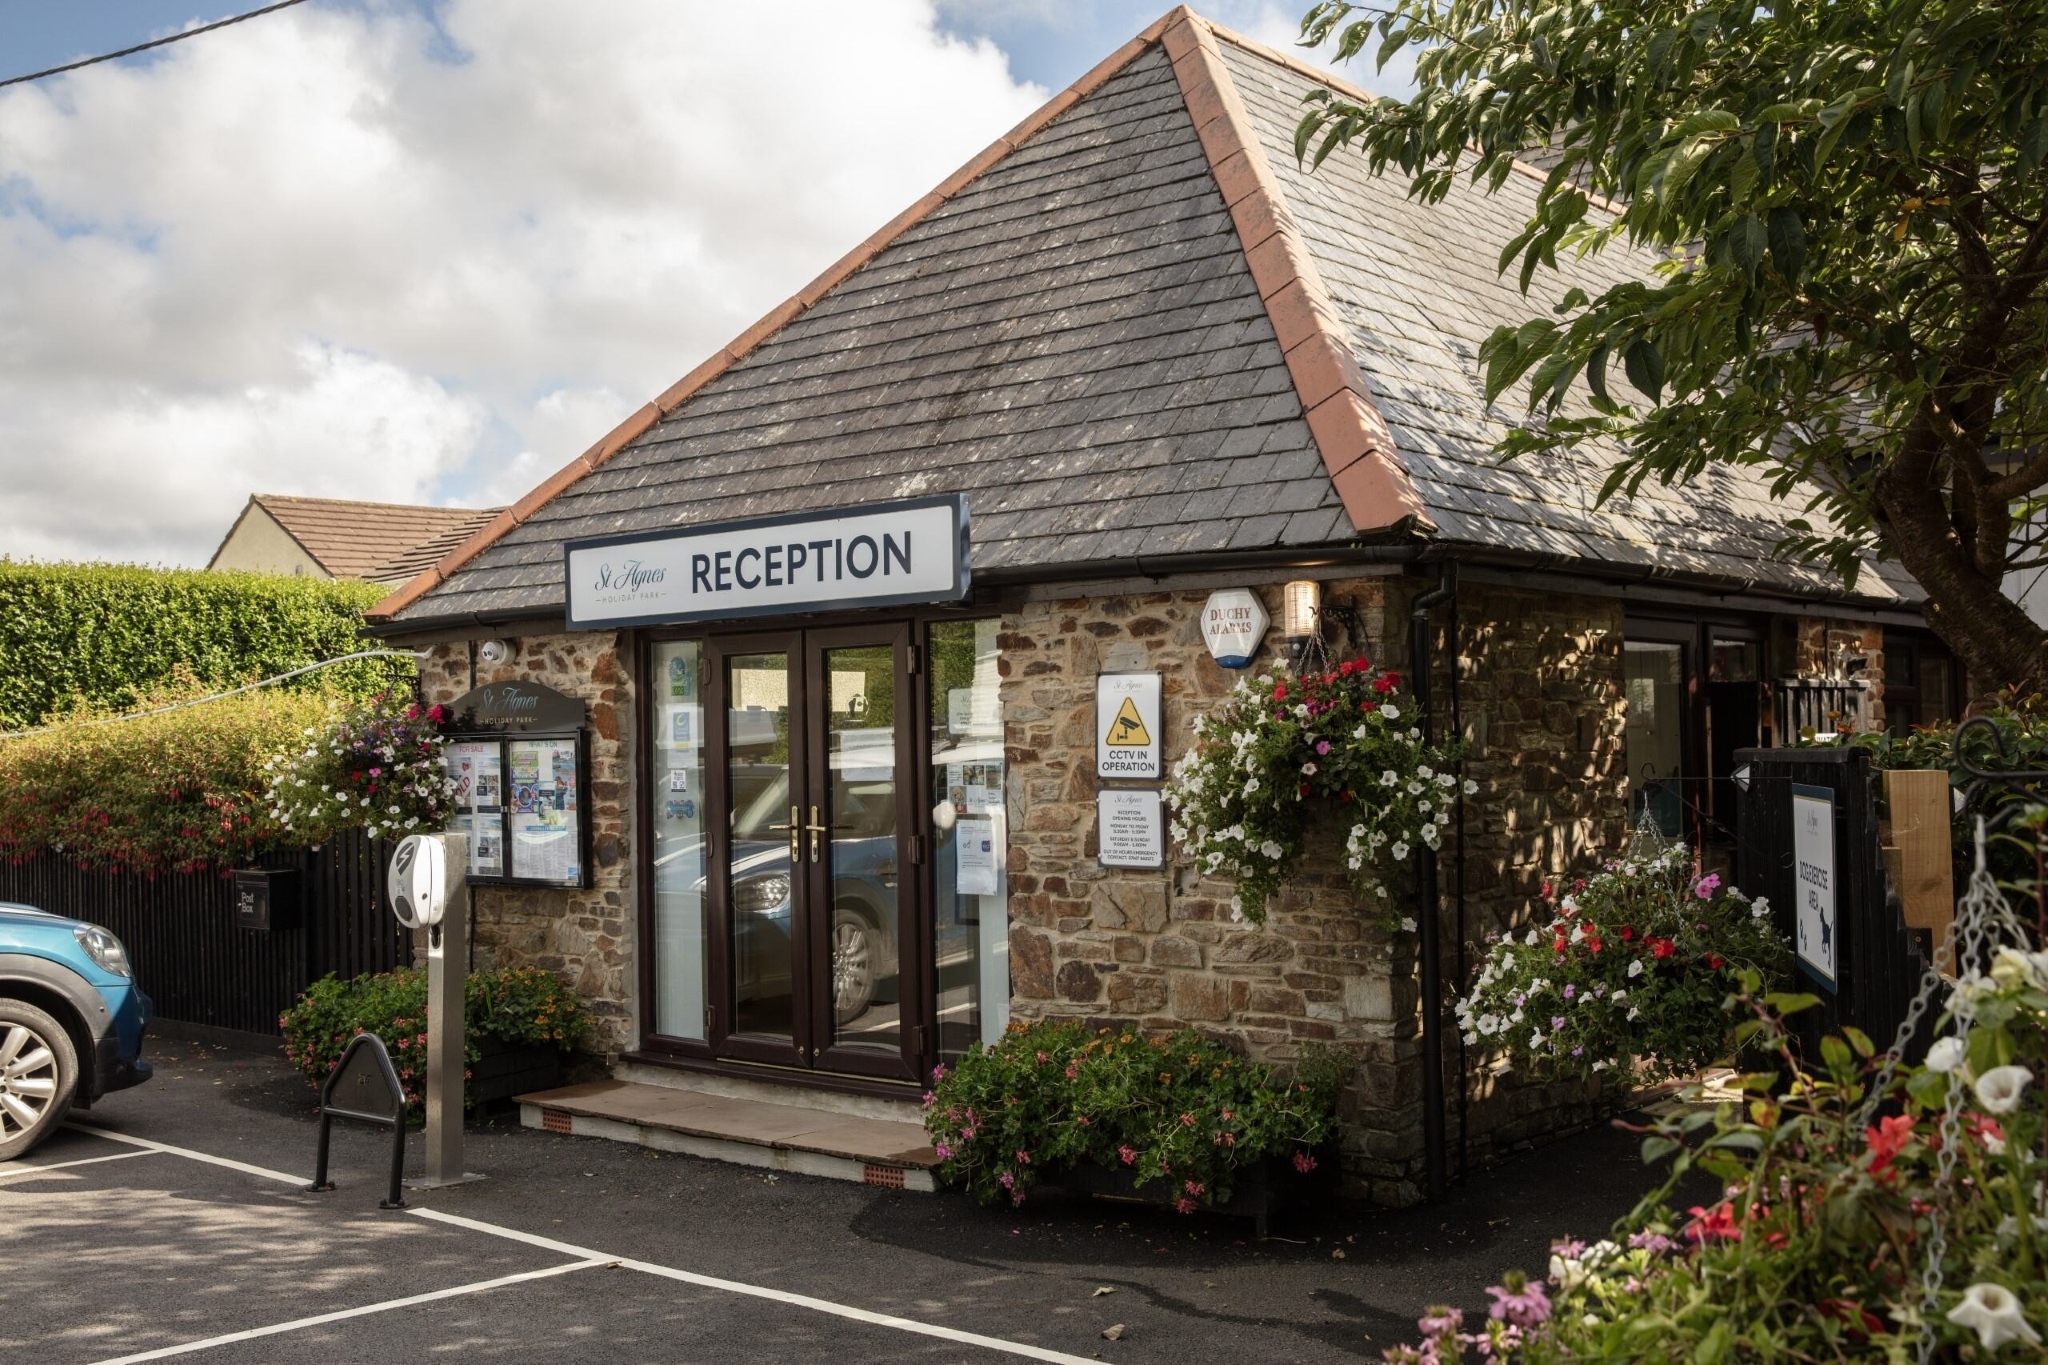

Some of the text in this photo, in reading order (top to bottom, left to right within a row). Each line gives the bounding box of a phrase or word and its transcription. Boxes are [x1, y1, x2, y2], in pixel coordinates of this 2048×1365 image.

[692, 531, 912, 594] RECEPTION
[594, 559, 667, 593] St Agnes
[602, 592, 660, 603] HOLIDAY PARK
[1210, 607, 1251, 621] DUCHY
[1210, 621, 1252, 635] ALARMS
[495, 686, 539, 715] Agnes
[484, 717, 513, 725] HOLIDAY
[460, 745, 484, 753] FOR SALE
[1109, 750, 1147, 760] CCTV IN
[1102, 762, 1155, 772] OPERATION
[1809, 864, 1828, 890] EXERCISE
[241, 892, 254, 903] Post
[241, 902, 254, 913] Box
